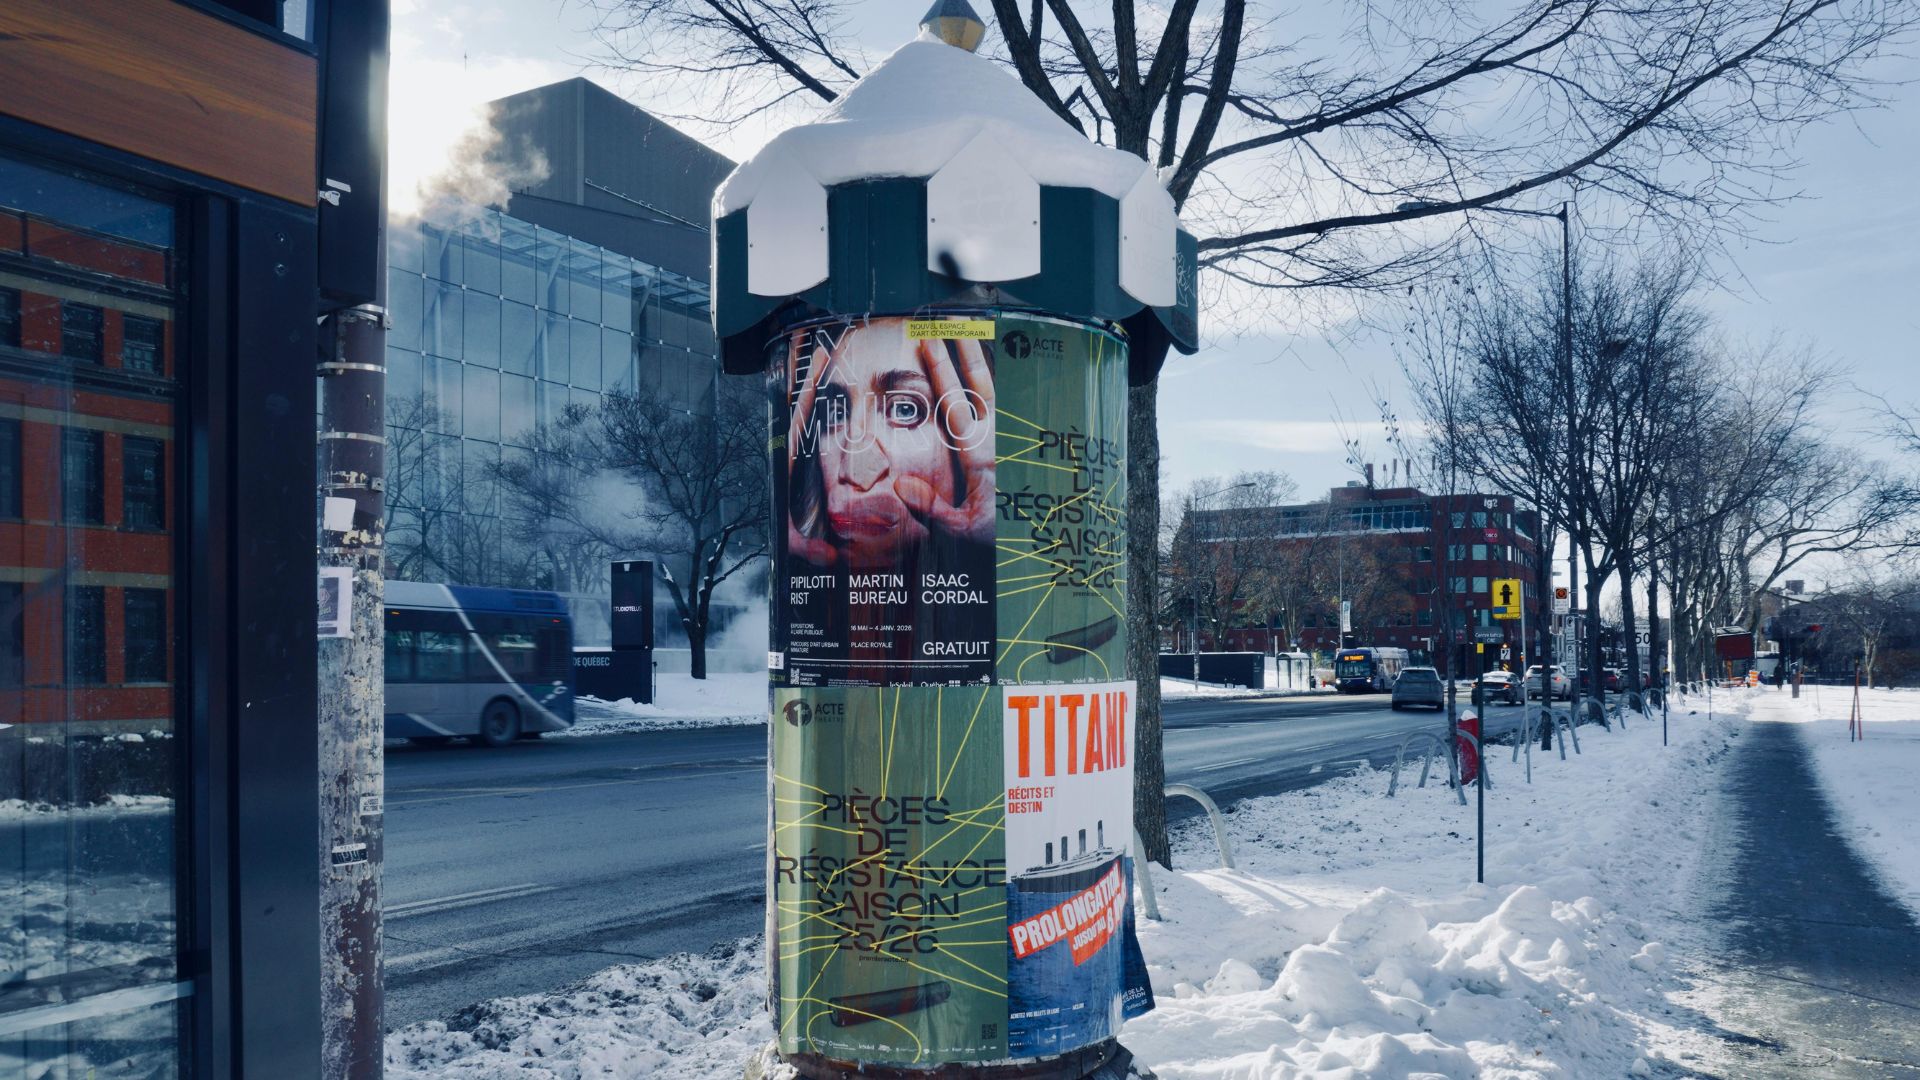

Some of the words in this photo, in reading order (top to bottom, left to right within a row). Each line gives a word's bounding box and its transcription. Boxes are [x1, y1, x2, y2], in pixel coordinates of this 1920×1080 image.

[1033, 337, 1064, 352] ACTE
[789, 325, 858, 395] EX
[789, 388, 990, 459] MURO
[1038, 424, 1119, 468] PIÈCES
[1073, 465, 1103, 497] DE
[995, 485, 1127, 531] RÉSISTANC
[1031, 525, 1121, 559] SAISON
[790, 575, 835, 589] PIPILOTTI
[849, 574, 903, 588] MARTIN
[922, 573, 970, 588] ISAAC
[1050, 558, 1115, 590] 25/26
[790, 592, 809, 605] RIST
[849, 591, 908, 605] BUREAU
[921, 590, 989, 604] CORDAL
[922, 641, 989, 655] GRATUIT
[1635, 633, 1651, 645] 50
[582, 656, 610, 668] QUÉBEC
[815, 703, 845, 716] ACTE
[1008, 785, 1041, 800] RÉCITS
[1044, 786, 1055, 799] ET
[822, 787, 950, 825] PIÈCES
[1008, 801, 1042, 814] DESTIN
[858, 827, 907, 857] DE
[776, 848, 1006, 889] RÉSISTANCE
[816, 889, 959, 922] SAISON
[1012, 862, 1120, 955] PROLONGATION
[834, 921, 939, 954] 25/26
